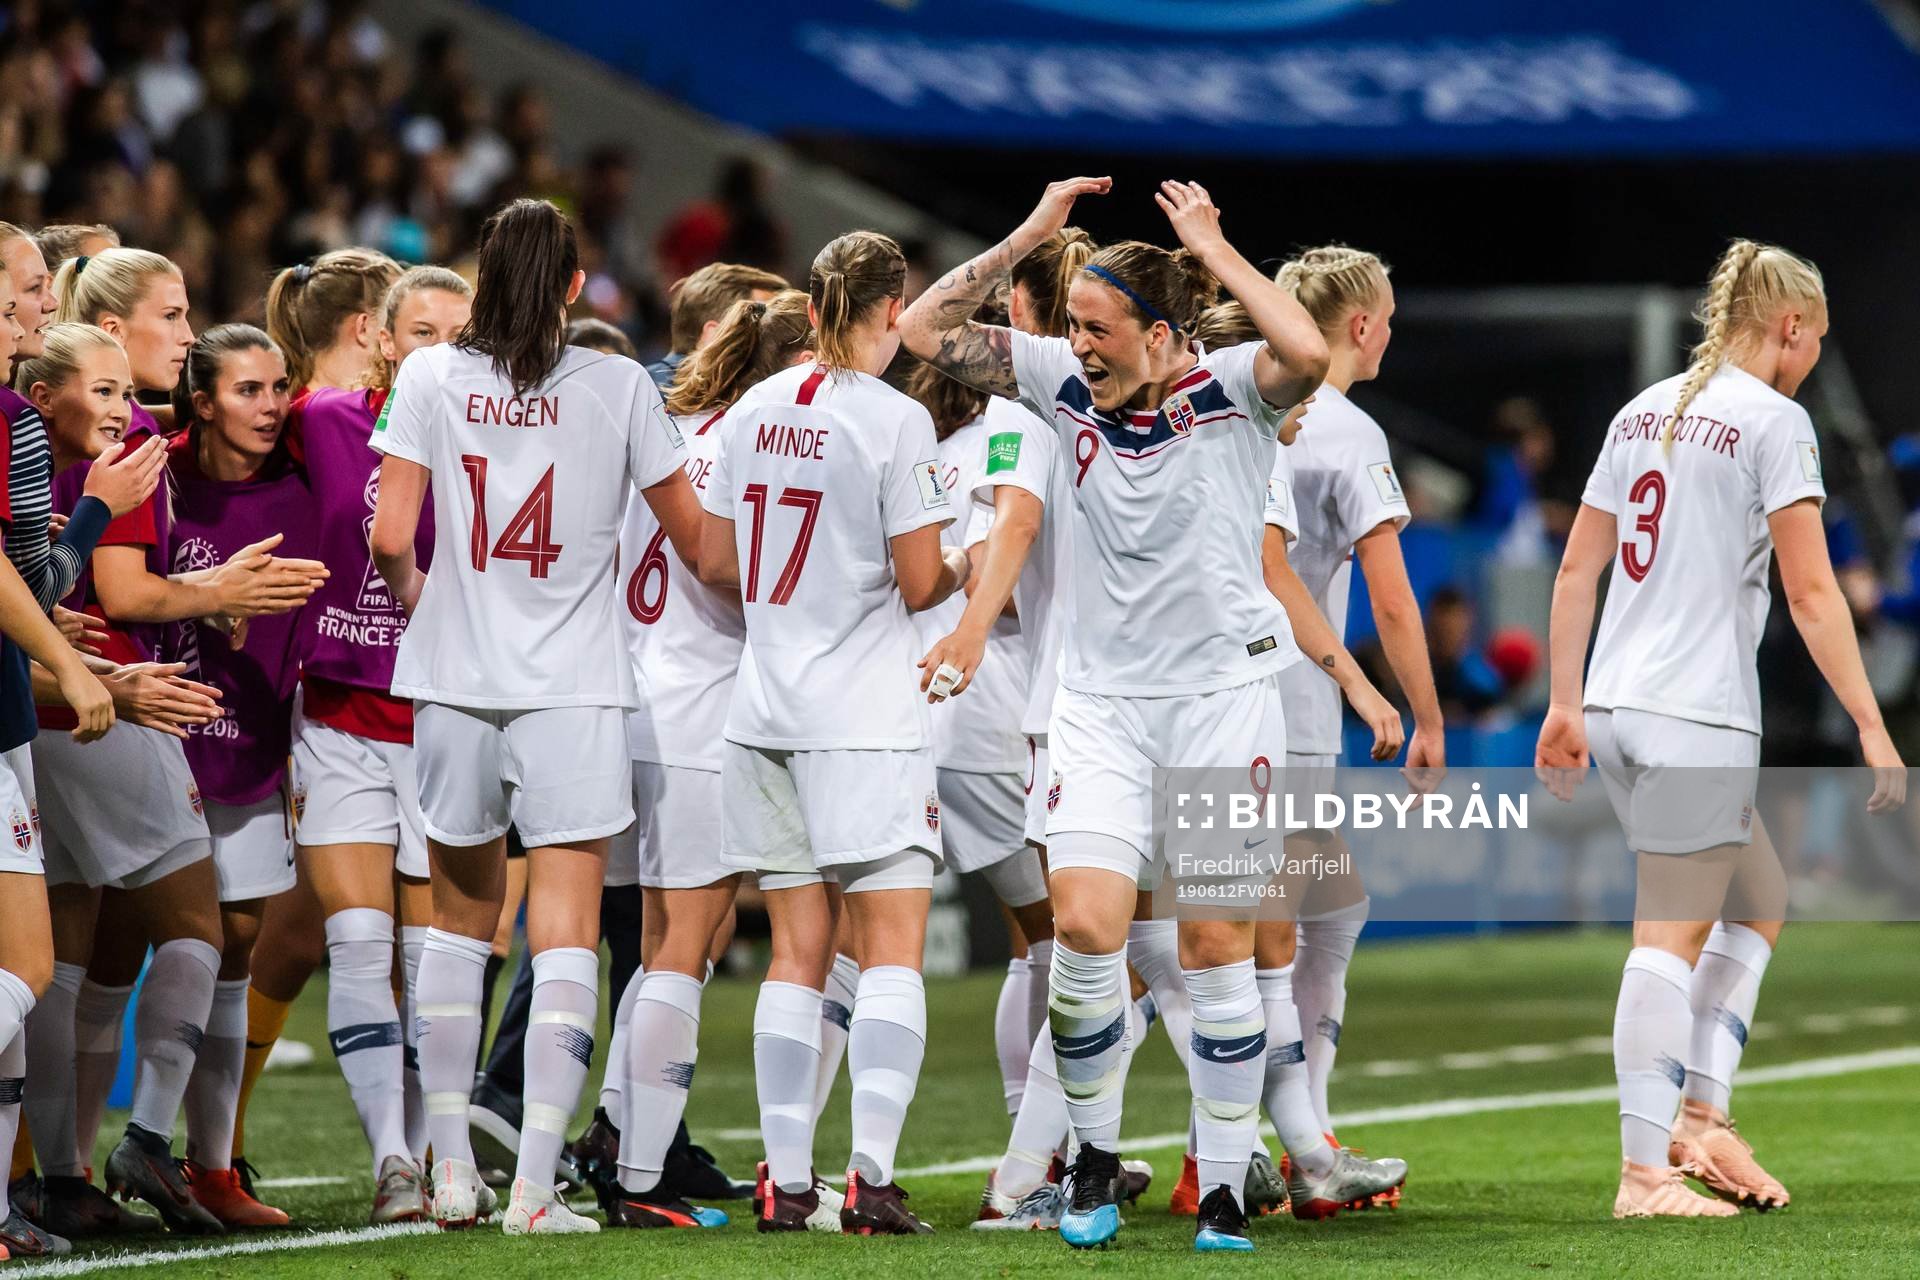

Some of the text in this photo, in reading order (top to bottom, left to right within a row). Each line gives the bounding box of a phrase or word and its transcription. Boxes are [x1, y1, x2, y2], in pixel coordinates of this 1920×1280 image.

[466, 393, 559, 427] ENGEN
[756, 423, 830, 461] MINDE
[1076, 429, 1099, 489] 9
[461, 453, 564, 579] 14
[1621, 469, 1666, 583] 3
[743, 483, 824, 606] 17
[626, 525, 669, 625] 6
[363, 594, 389, 607] FIFA
[371, 615, 407, 626] WORLD
[316, 615, 390, 647] FRANCE
[203, 718, 240, 739] 2019
[1249, 755, 1272, 818] 9
